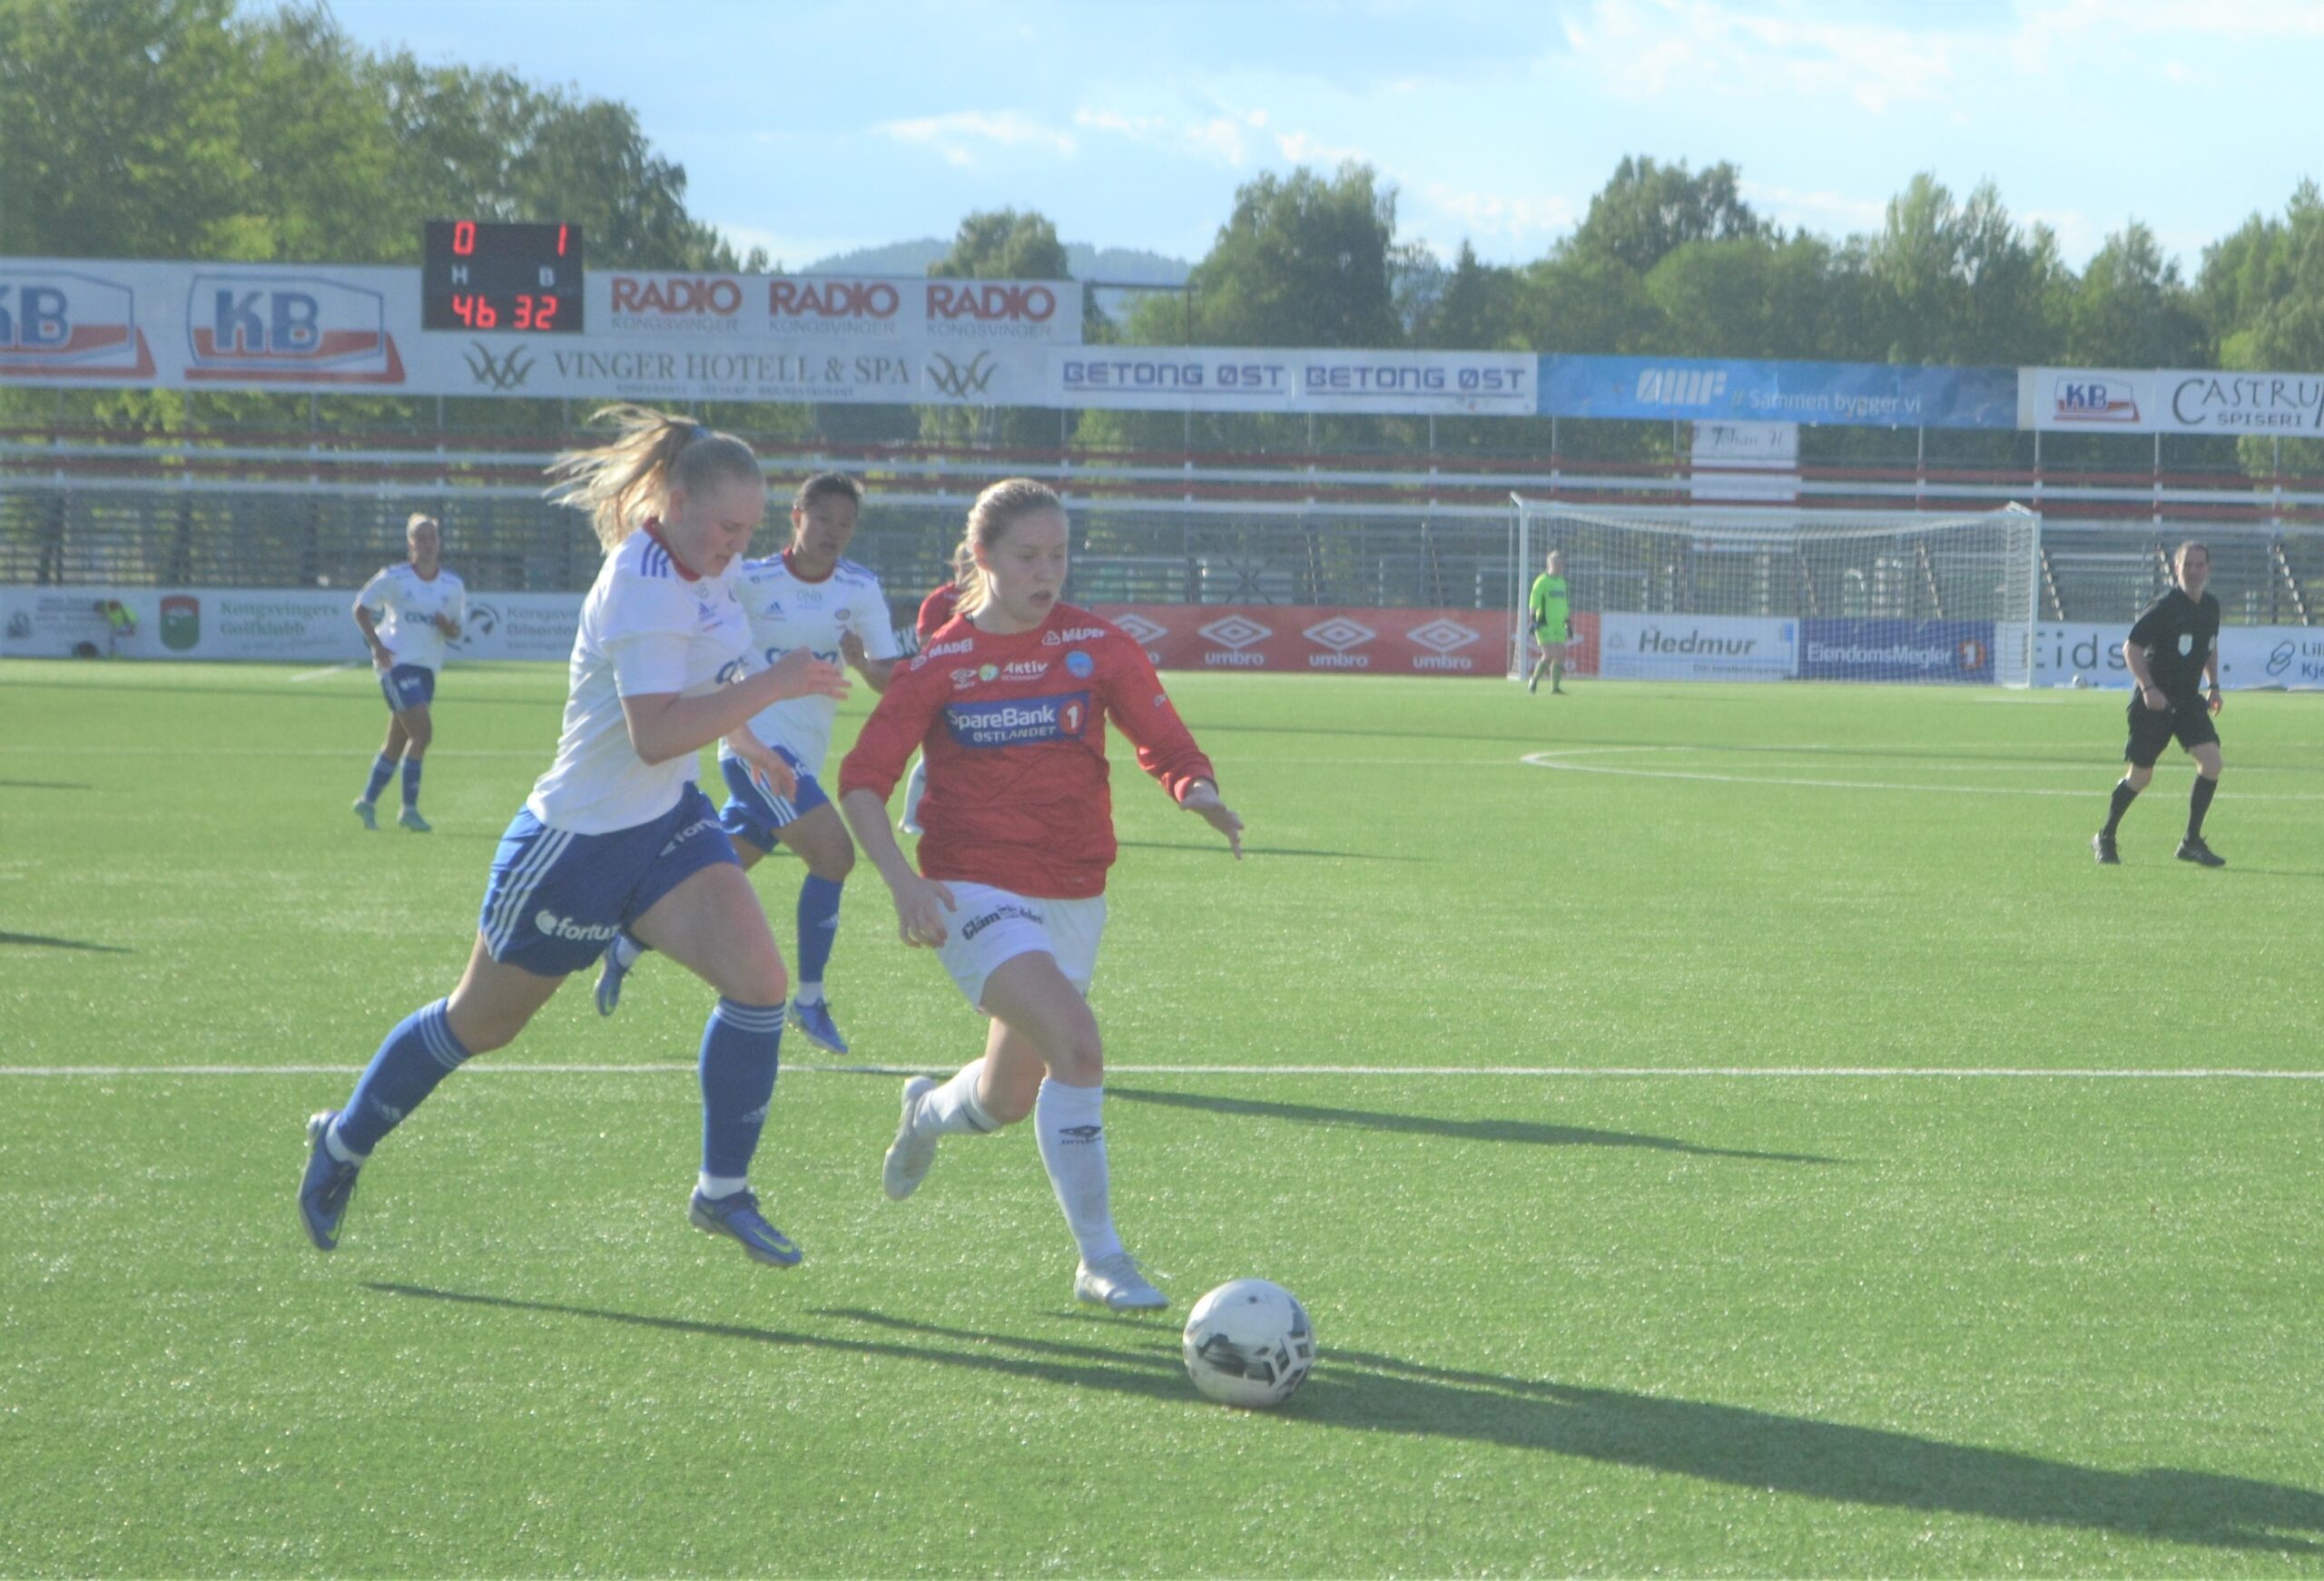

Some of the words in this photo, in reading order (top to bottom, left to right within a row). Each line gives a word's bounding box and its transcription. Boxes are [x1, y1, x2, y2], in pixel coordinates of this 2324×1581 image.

[453, 220, 476, 255] 0
[557, 222, 567, 257] 1
[451, 264, 468, 286] H
[538, 265, 555, 288] B
[612, 277, 742, 315] RADIO
[769, 280, 900, 319] RADIO
[926, 283, 1055, 321] RADIO
[0, 284, 69, 344] B
[214, 290, 320, 352] KB
[452, 294, 497, 329] 46
[513, 294, 558, 329] 32
[612, 318, 739, 333] KONGSVINGER
[769, 320, 896, 336] KONGSVINGER
[926, 323, 1051, 339] KONGSVINGER
[553, 350, 675, 379] VINGER
[686, 352, 816, 384] HOTELL
[823, 356, 845, 383] &
[854, 355, 911, 385] SPA
[1063, 362, 1203, 387] BETONG
[1216, 363, 1285, 388] ØST
[1305, 366, 1444, 389] BETONG
[1458, 368, 1525, 390] ØST
[1749, 388, 1828, 410] Sammen
[1835, 391, 1899, 417] bygger
[1905, 396, 1922, 414] vi
[2065, 383, 2107, 409] KB
[2172, 377, 2324, 428] CASTRU
[2217, 412, 2302, 427] SPISERI
[1638, 628, 1757, 655] Hedmur
[1002, 660, 1049, 674] Aktiv
[1204, 650, 1265, 666] umbro
[1309, 652, 1369, 668] umbro
[1413, 653, 1472, 670] umbro
[947, 704, 1056, 731] SpareBank
[972, 725, 1057, 743] ØSTLANDET
